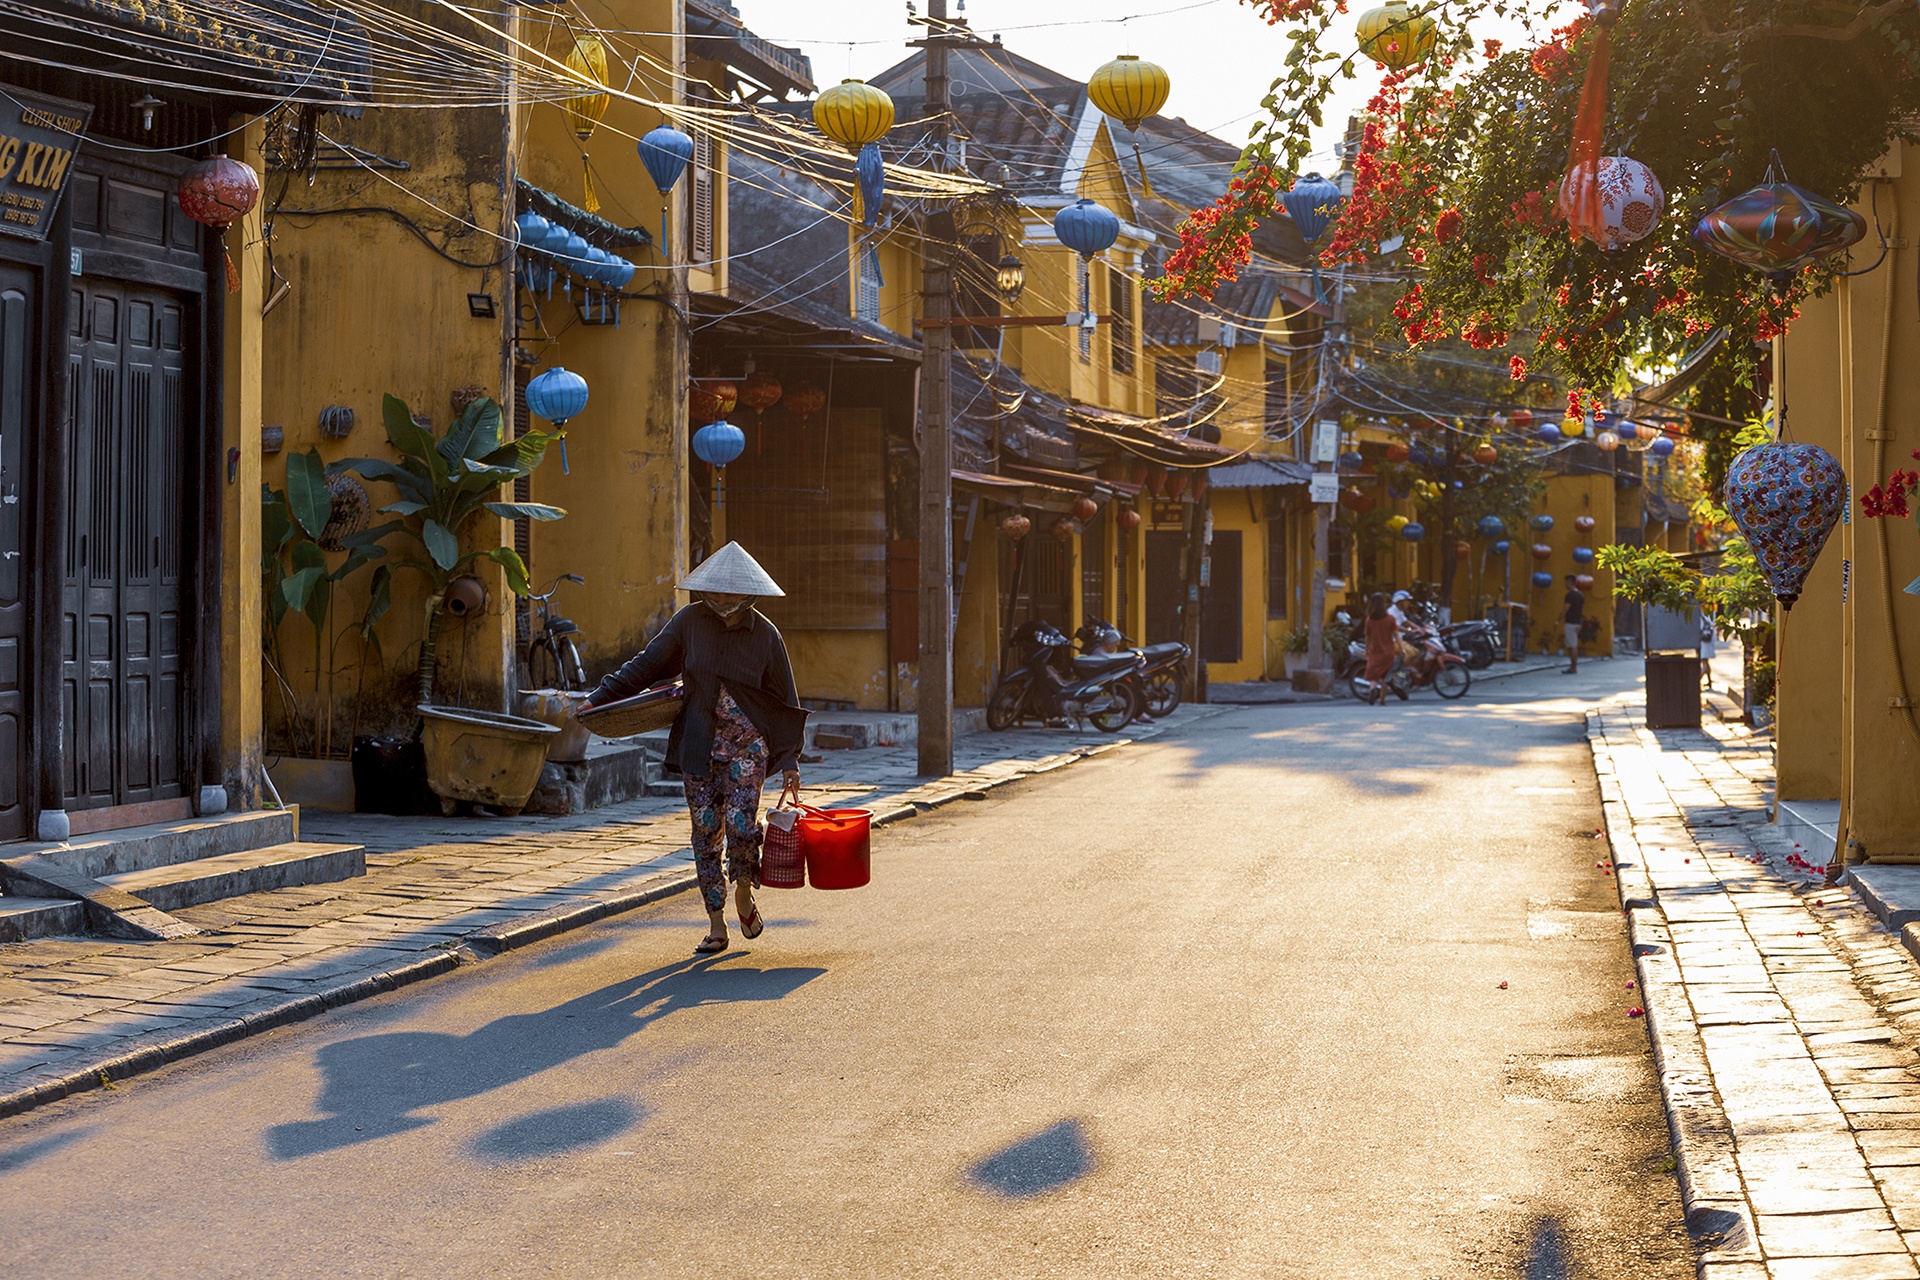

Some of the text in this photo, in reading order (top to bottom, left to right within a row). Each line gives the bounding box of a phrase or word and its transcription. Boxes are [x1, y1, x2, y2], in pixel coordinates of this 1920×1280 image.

[22, 106, 82, 133] CLOTH SHOP
[0, 134, 72, 191] G KIM
